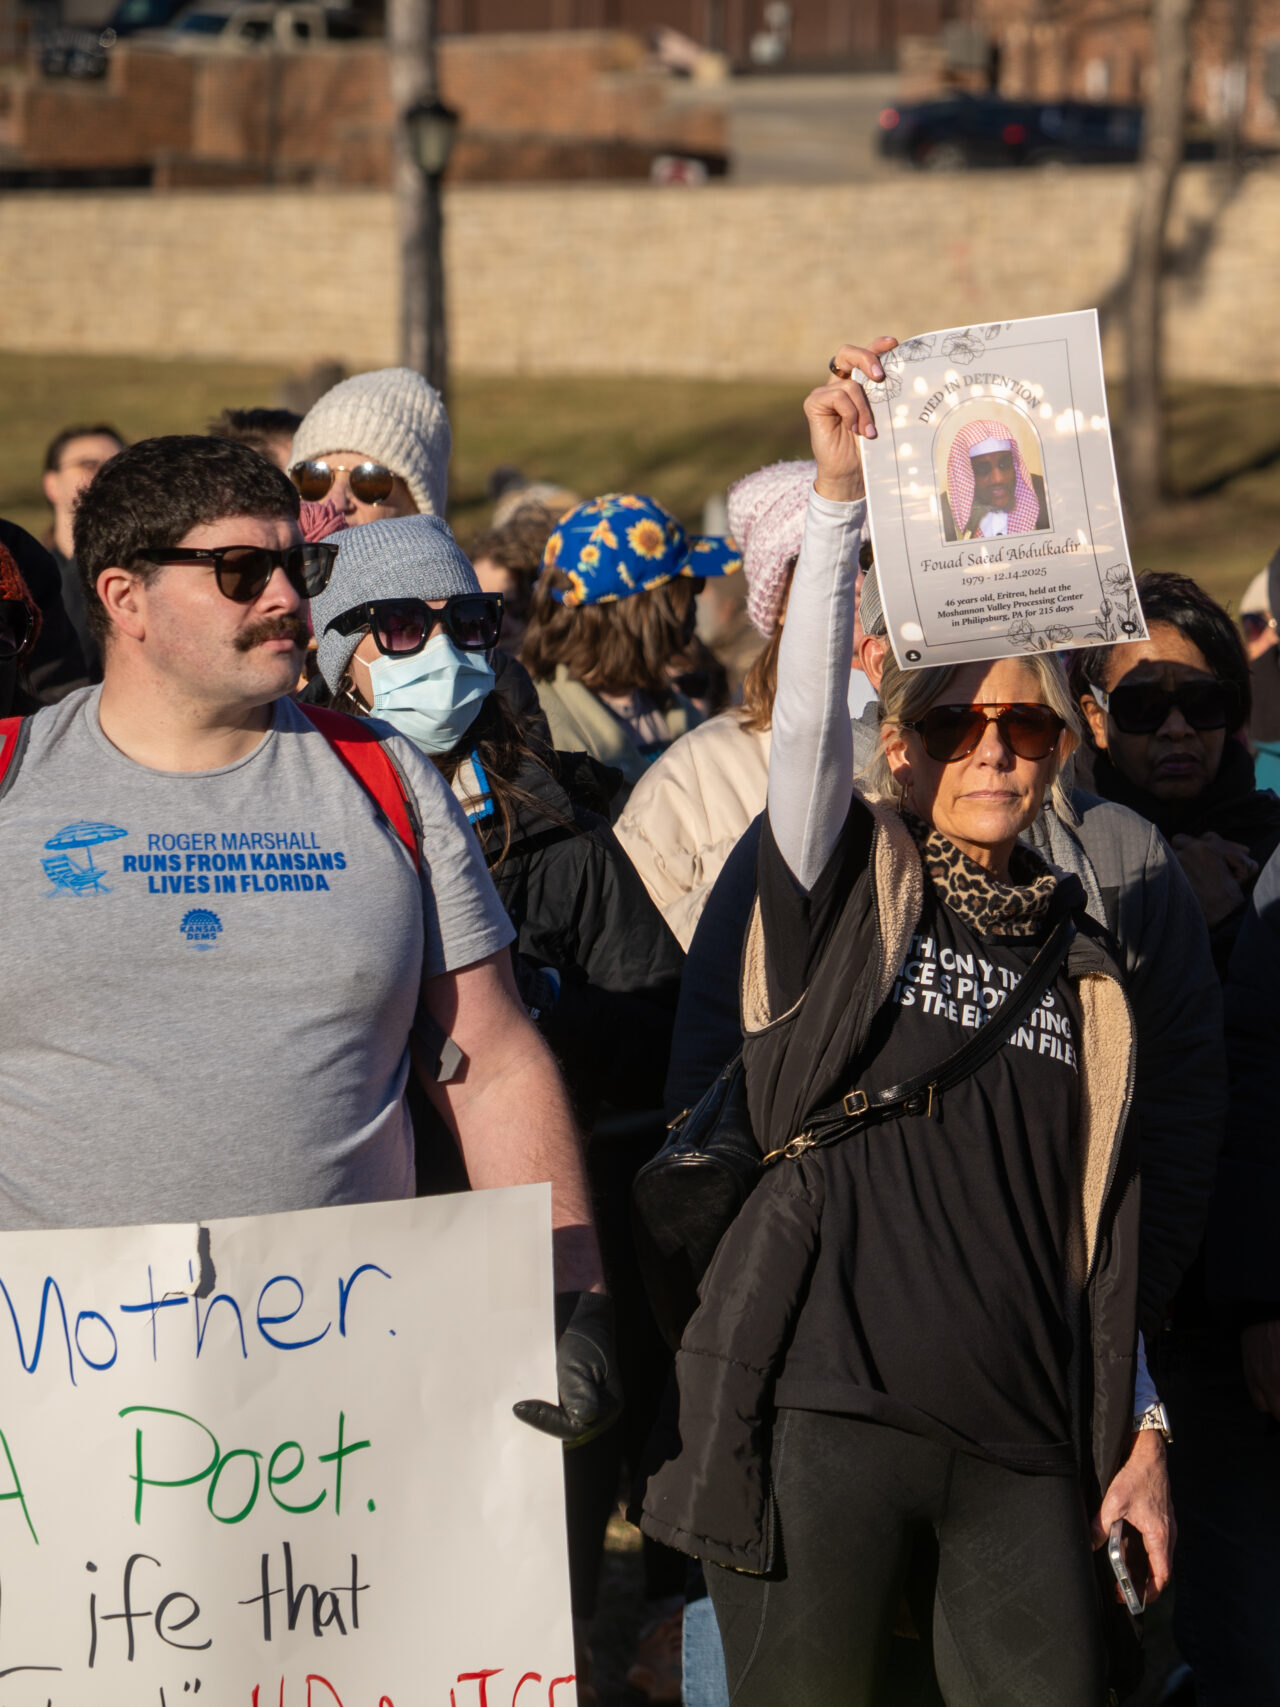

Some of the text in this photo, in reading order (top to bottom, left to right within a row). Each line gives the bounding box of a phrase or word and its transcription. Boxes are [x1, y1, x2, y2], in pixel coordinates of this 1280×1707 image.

[918, 373, 1041, 424] DIED IN DETENTION
[920, 552, 963, 572] Fouad
[1006, 538, 1080, 562] Abdulkadir
[961, 575, 985, 586] 1979
[994, 568, 1047, 582] 12.14.2025
[937, 593, 1084, 619] Moshannon Valley Processing Center
[945, 599, 955, 607] 46
[956, 597, 978, 607] years
[980, 593, 995, 603] old,
[997, 590, 1028, 601] Eritrea,
[1029, 585, 1046, 596] held
[1058, 583, 1071, 592] the
[1012, 611, 1023, 619] PA
[1025, 609, 1037, 619] for
[1039, 607, 1054, 616] 215
[1055, 604, 1074, 614] days
[148, 831, 321, 851] ROGER MARSHALL
[123, 852, 347, 872] RUNS FROM KANSANS
[148, 874, 330, 894] LIVES IN FLORIDA
[179, 924, 223, 933] KANSAS
[922, 990, 958, 1022] THE
[119, 1405, 376, 1525] Poet.
[238, 1541, 371, 1642] that
